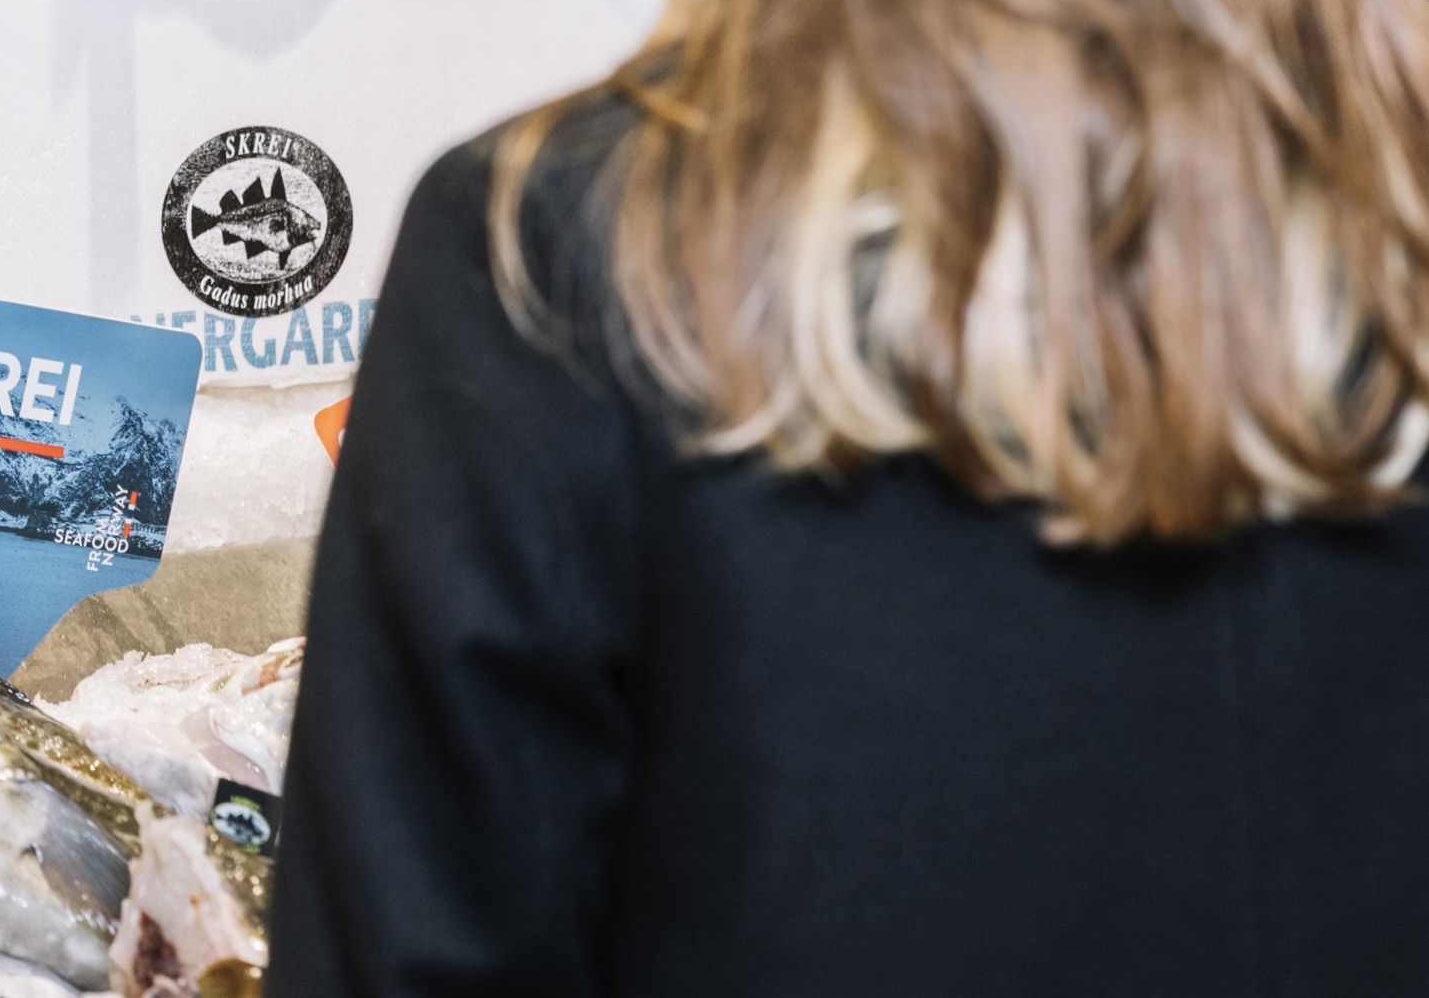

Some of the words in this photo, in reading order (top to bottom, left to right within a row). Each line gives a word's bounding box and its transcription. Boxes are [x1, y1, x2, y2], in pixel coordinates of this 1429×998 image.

[200, 275, 249, 309] Gadus
[253, 275, 313, 309] morhua
[54, 528, 129, 554] SEAFOOD
